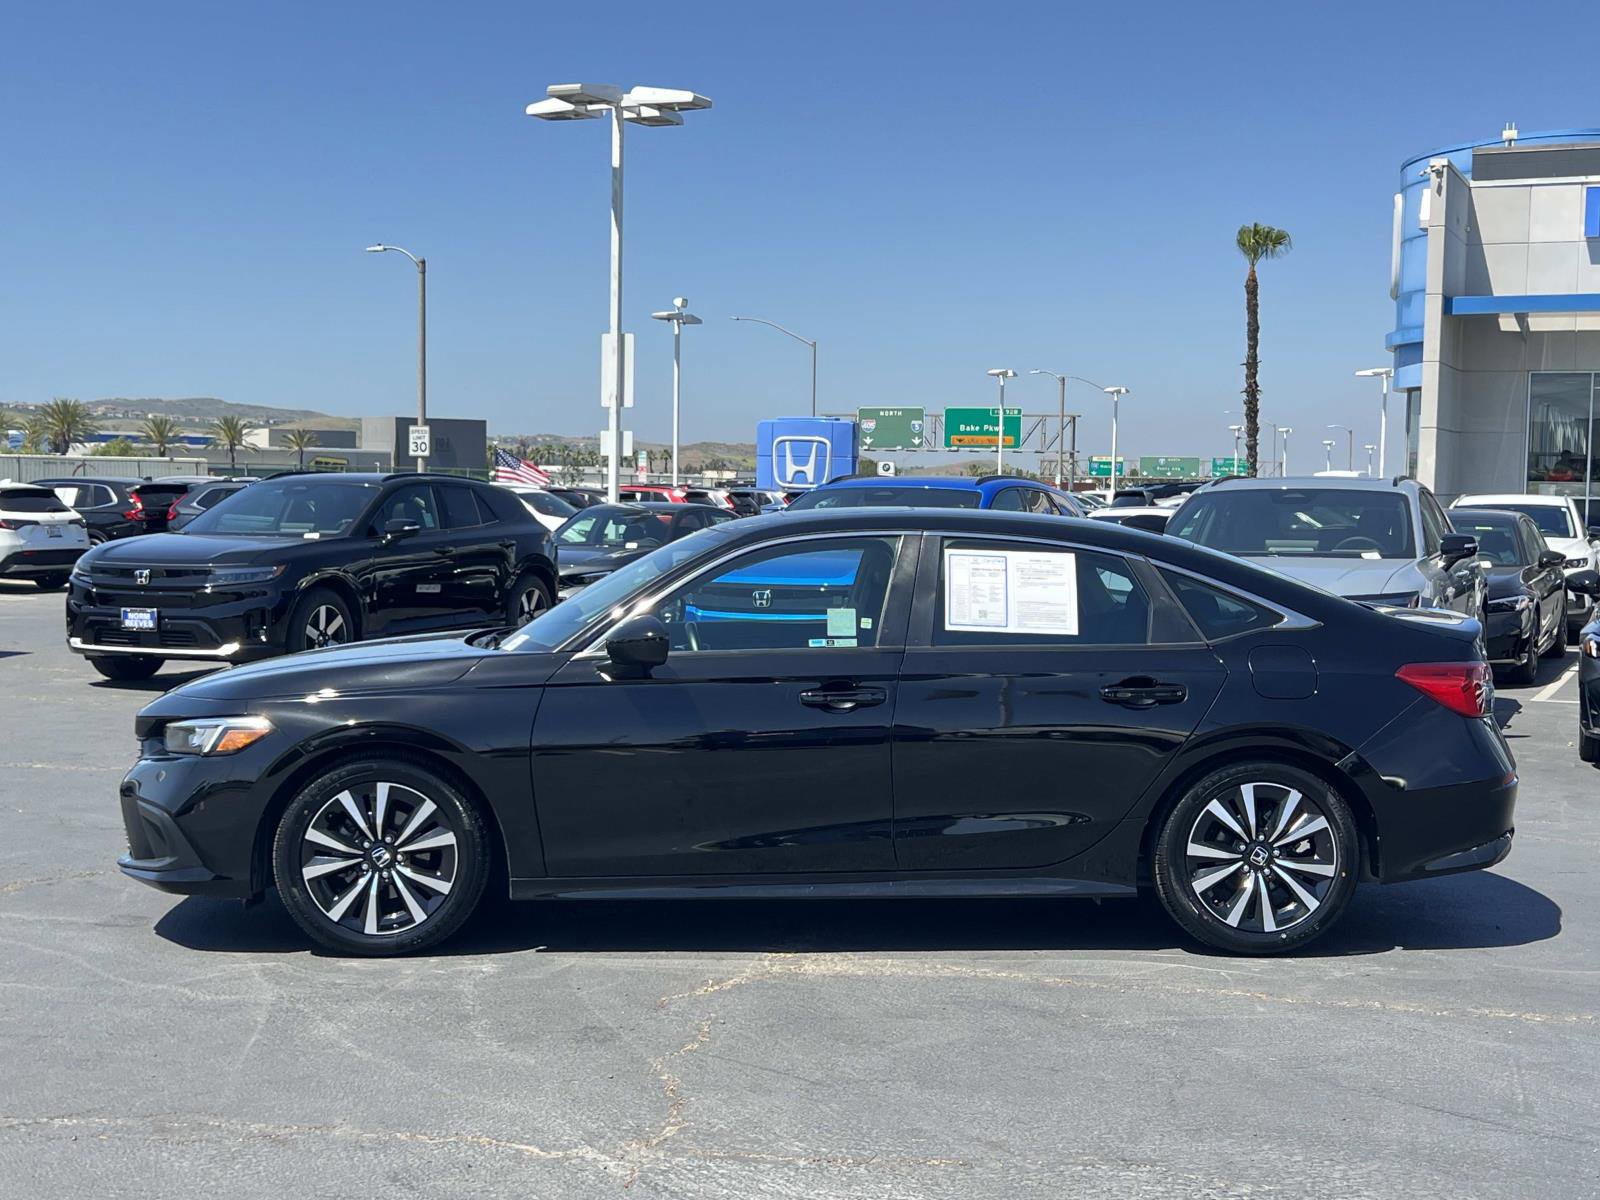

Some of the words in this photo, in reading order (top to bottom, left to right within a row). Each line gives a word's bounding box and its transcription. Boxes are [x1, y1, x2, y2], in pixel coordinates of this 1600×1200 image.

[960, 424, 980, 432] Bake
[983, 424, 1004, 432] Pkw
[411, 441, 428, 453] 30
